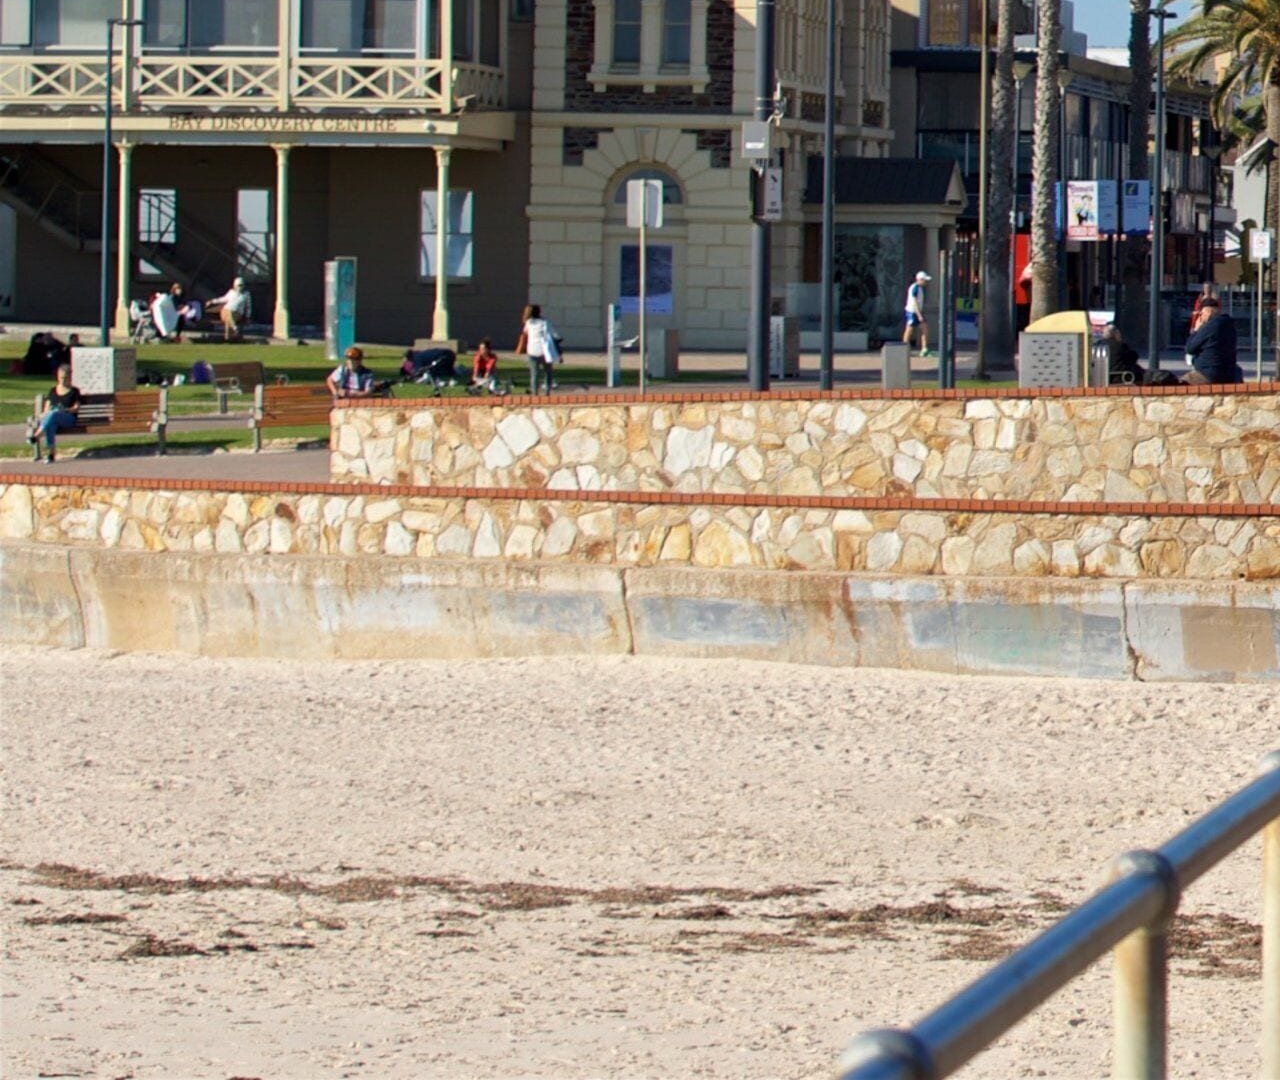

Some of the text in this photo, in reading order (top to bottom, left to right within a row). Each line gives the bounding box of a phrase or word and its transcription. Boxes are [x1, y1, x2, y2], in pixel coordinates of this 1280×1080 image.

[169, 117, 398, 132] BAY DISCOVERY CENTRE
